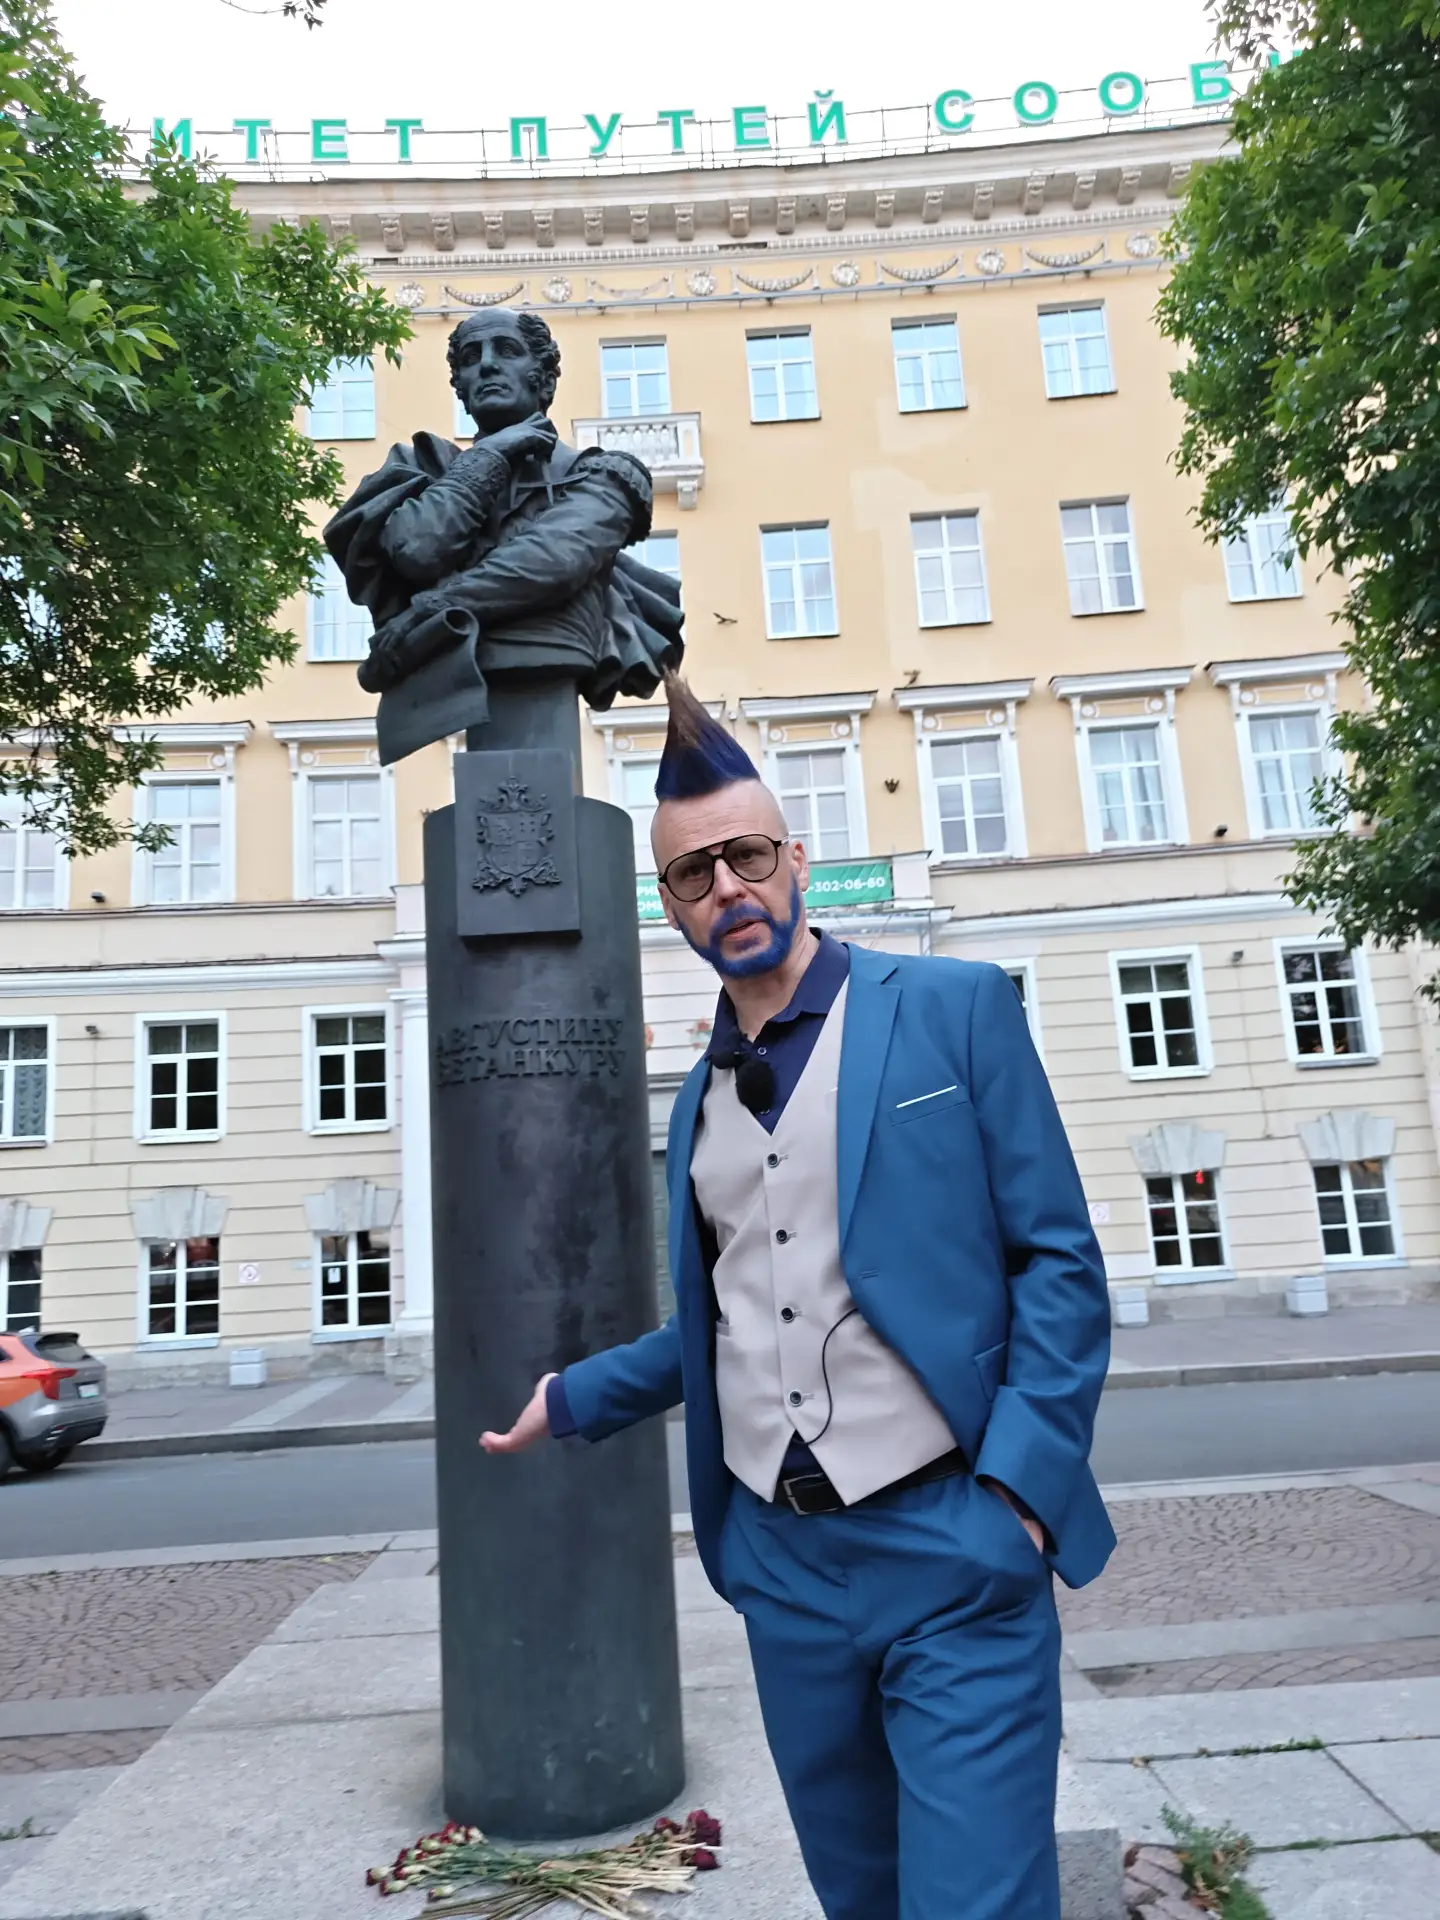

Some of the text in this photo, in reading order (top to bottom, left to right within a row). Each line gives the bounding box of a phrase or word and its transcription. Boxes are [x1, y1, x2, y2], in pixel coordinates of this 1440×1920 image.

[152, 49, 1303, 164] ИТЕТ ПУТЕЙ СООБ
